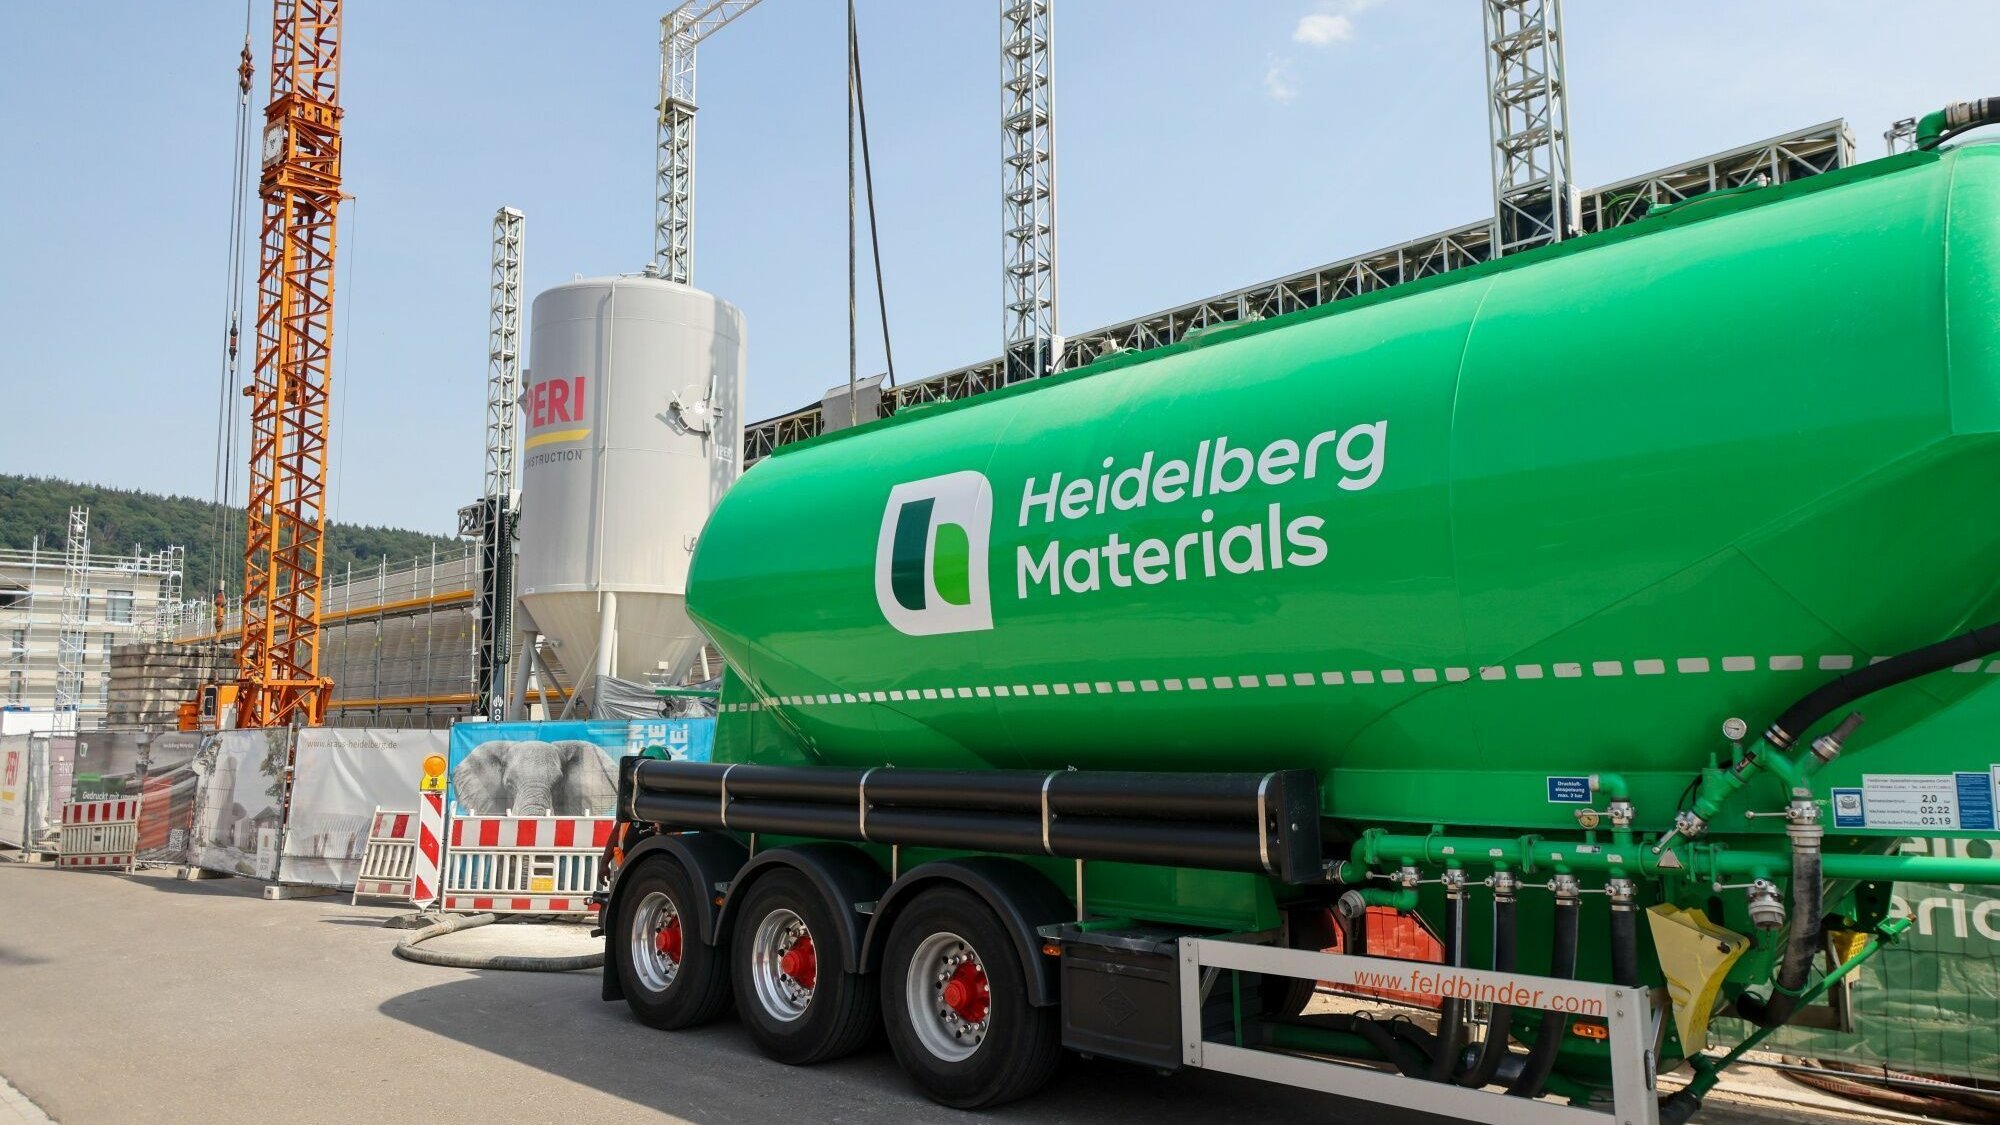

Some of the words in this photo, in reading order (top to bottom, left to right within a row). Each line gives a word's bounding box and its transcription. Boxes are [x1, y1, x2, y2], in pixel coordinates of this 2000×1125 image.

[526, 376, 585, 428] PERI
[1017, 419, 1388, 527] Heidelberg
[1016, 502, 1329, 600] Materials
[307, 740, 398, 750] www.kraus-heidelberg.de
[83, 791, 108, 800] Gedruckt
[110, 792, 119, 800] mit
[1922, 794, 1938, 804] 2,0
[1920, 806, 1950, 814] 02.22
[1921, 816, 1952, 825] 02.19
[1354, 970, 1603, 1014] www.feldbinder.com
